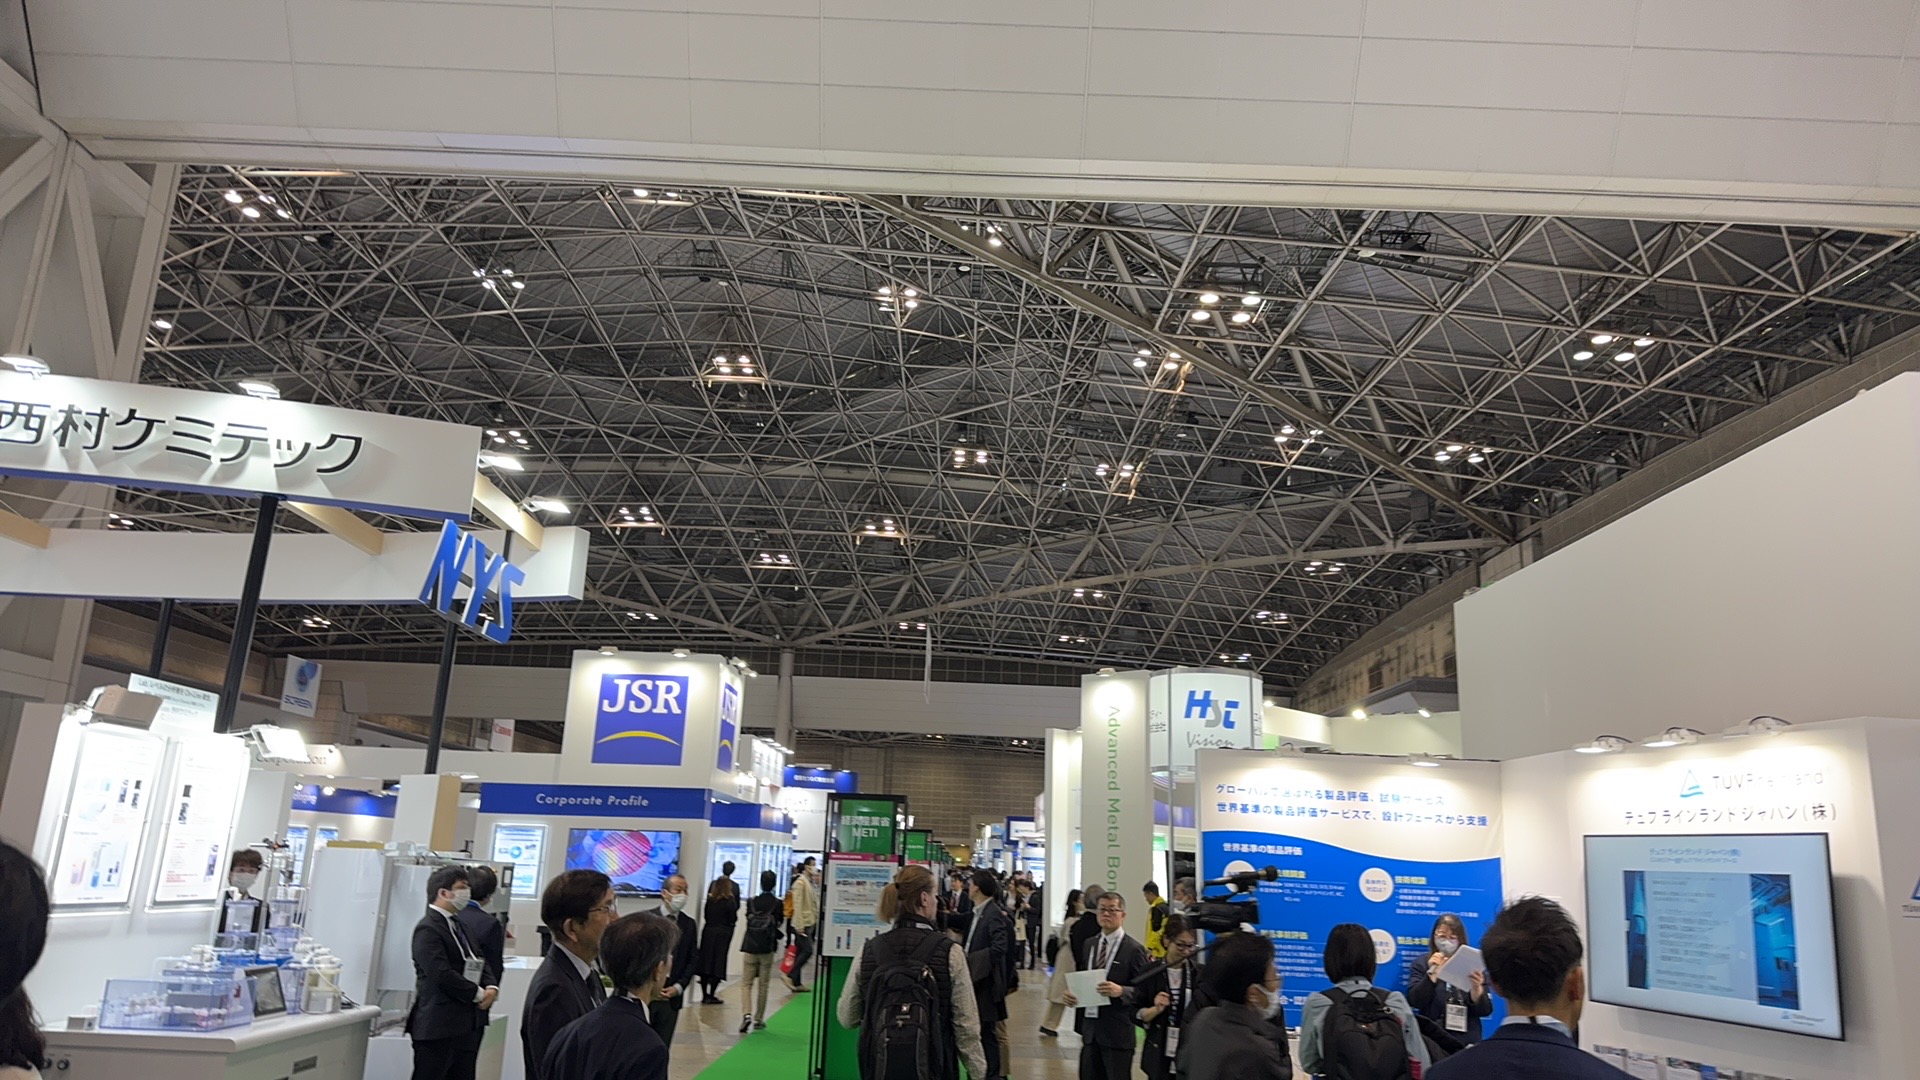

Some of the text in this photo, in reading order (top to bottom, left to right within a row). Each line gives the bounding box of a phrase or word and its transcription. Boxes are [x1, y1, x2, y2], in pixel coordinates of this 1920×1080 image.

[0, 402, 363, 474] 西村ケミテック
[418, 519, 526, 644] NYS
[602, 678, 682, 714] JSR
[1107, 705, 1121, 791] Advanced
[1187, 731, 1236, 748] Vision
[536, 793, 649, 807] Corporate Profile
[852, 828, 878, 838] METI
[1107, 798, 1121, 849] Metal
[1223, 843, 1303, 856] 世界基準の製品評価
